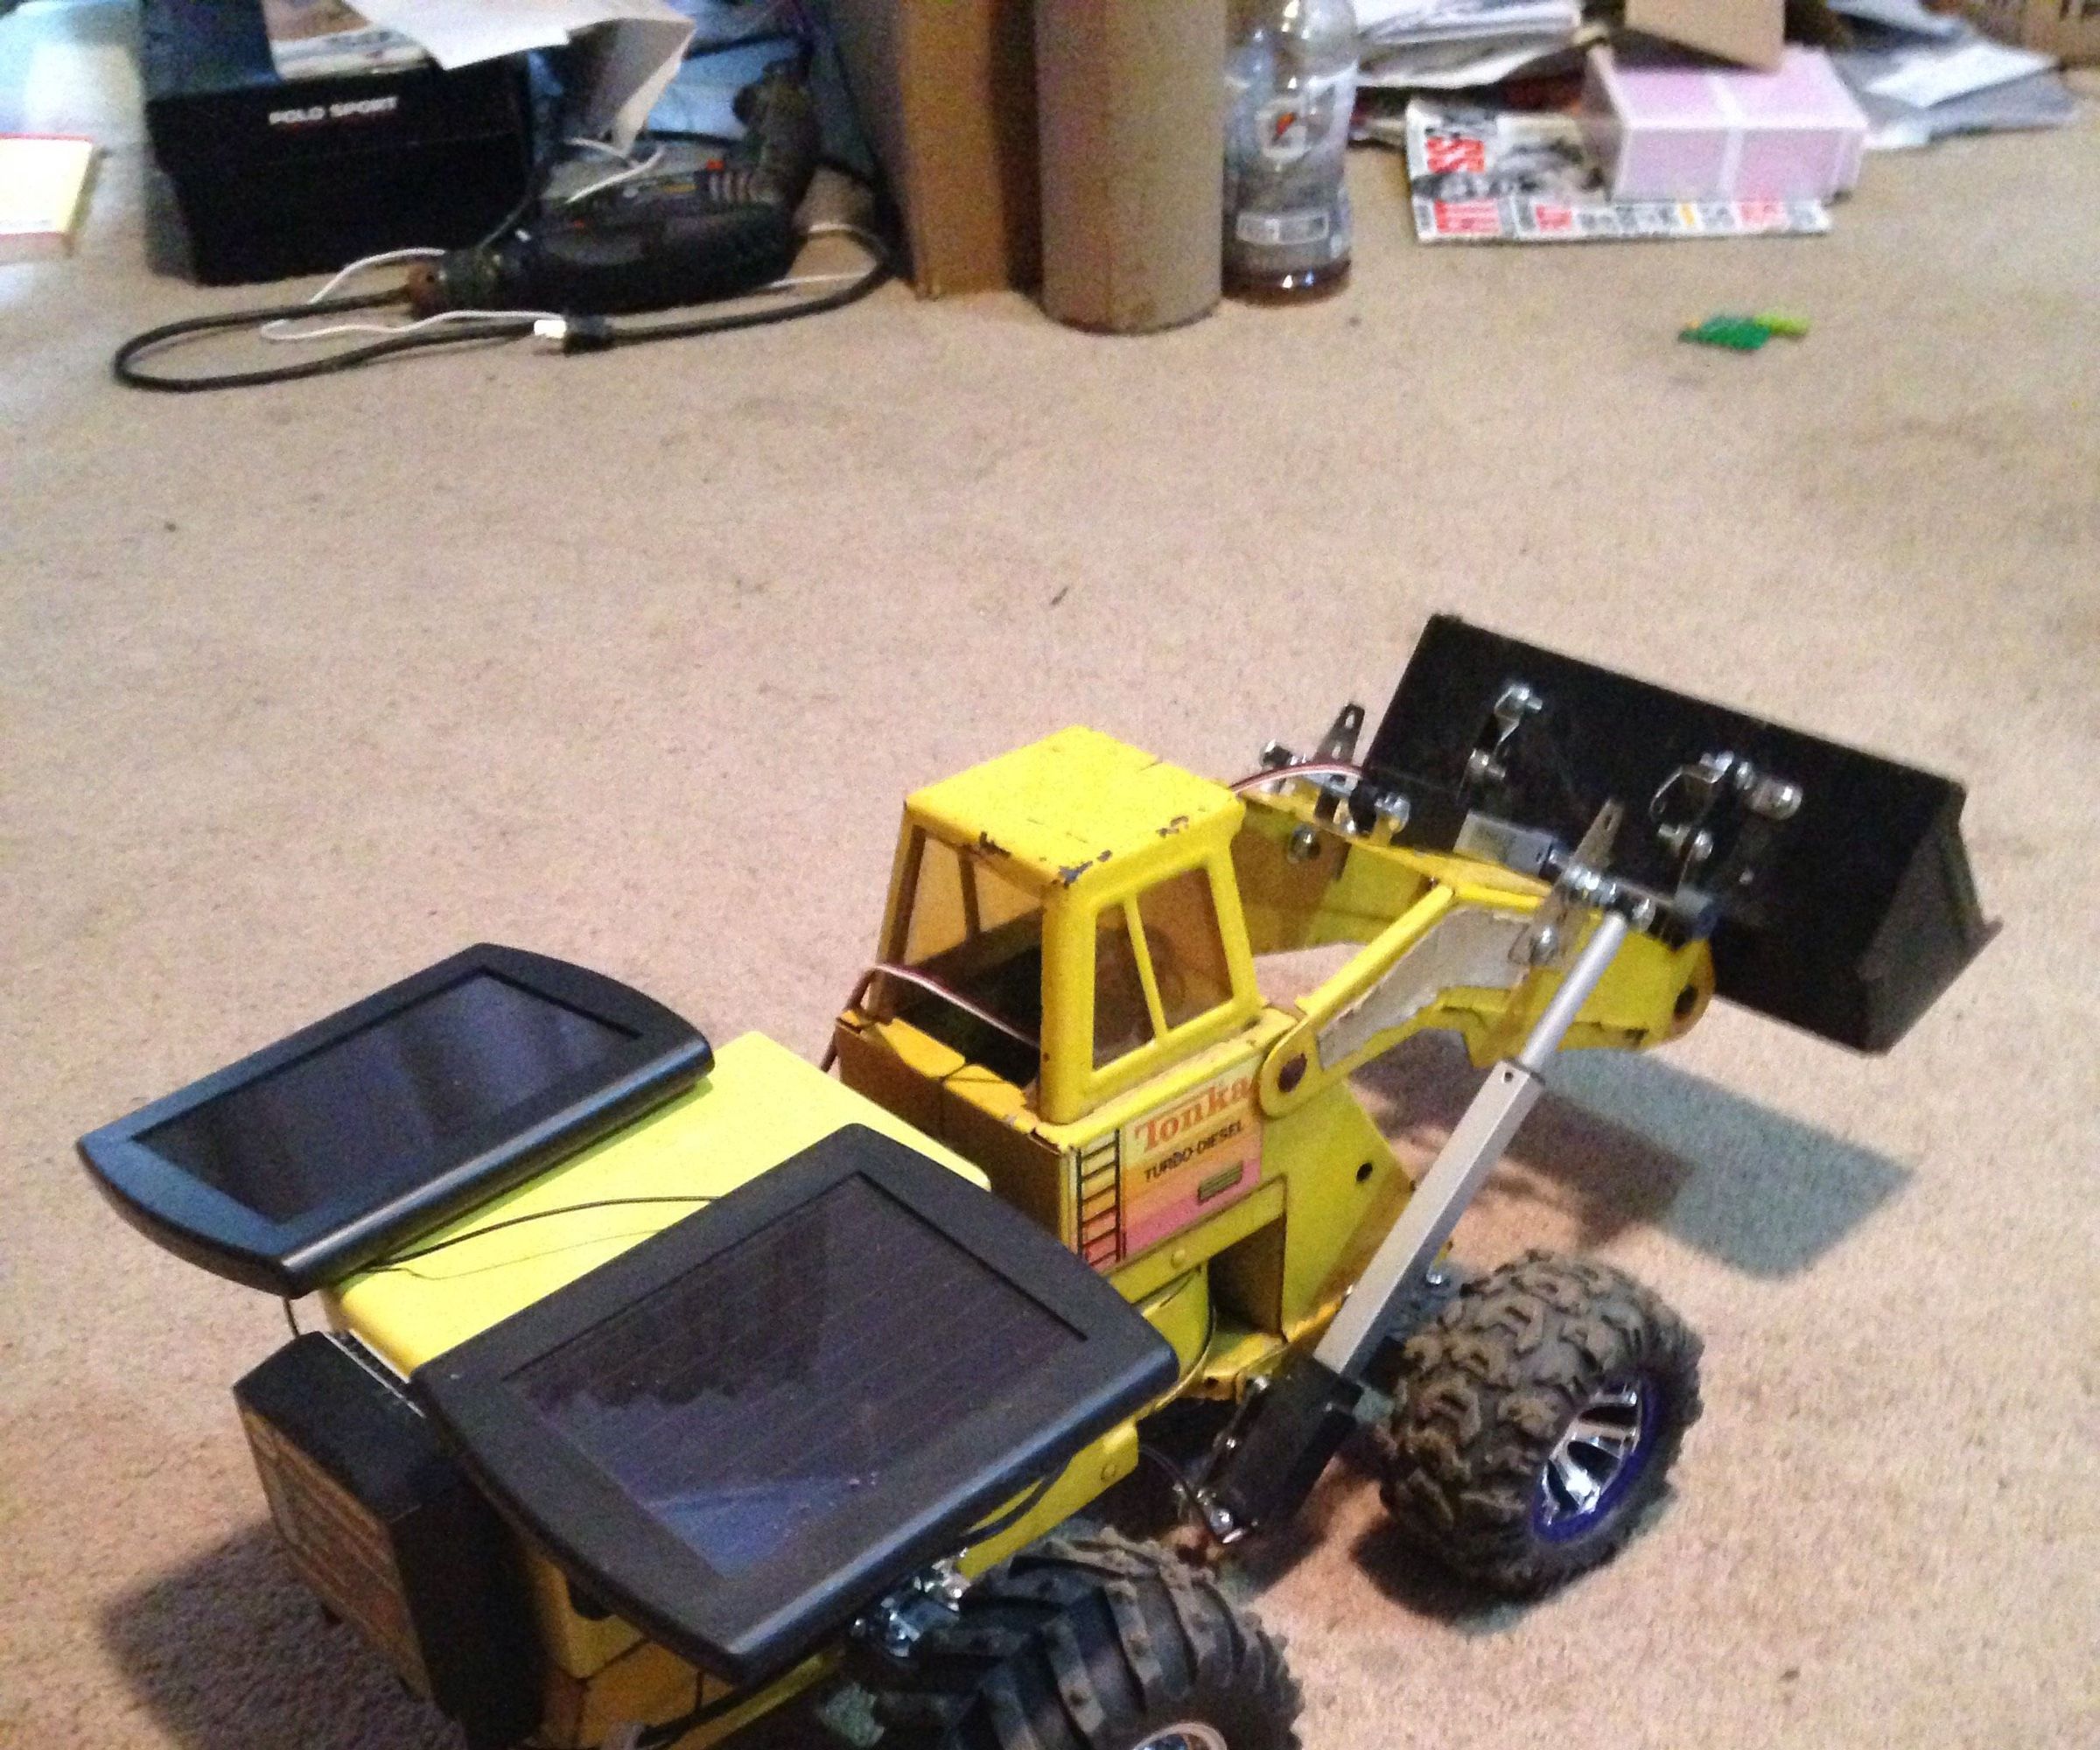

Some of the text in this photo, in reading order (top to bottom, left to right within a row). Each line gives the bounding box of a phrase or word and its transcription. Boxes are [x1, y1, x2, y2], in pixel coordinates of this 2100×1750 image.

[268, 96, 399, 125] POLO SPORT
[1134, 1077, 1255, 1152] Tonka
